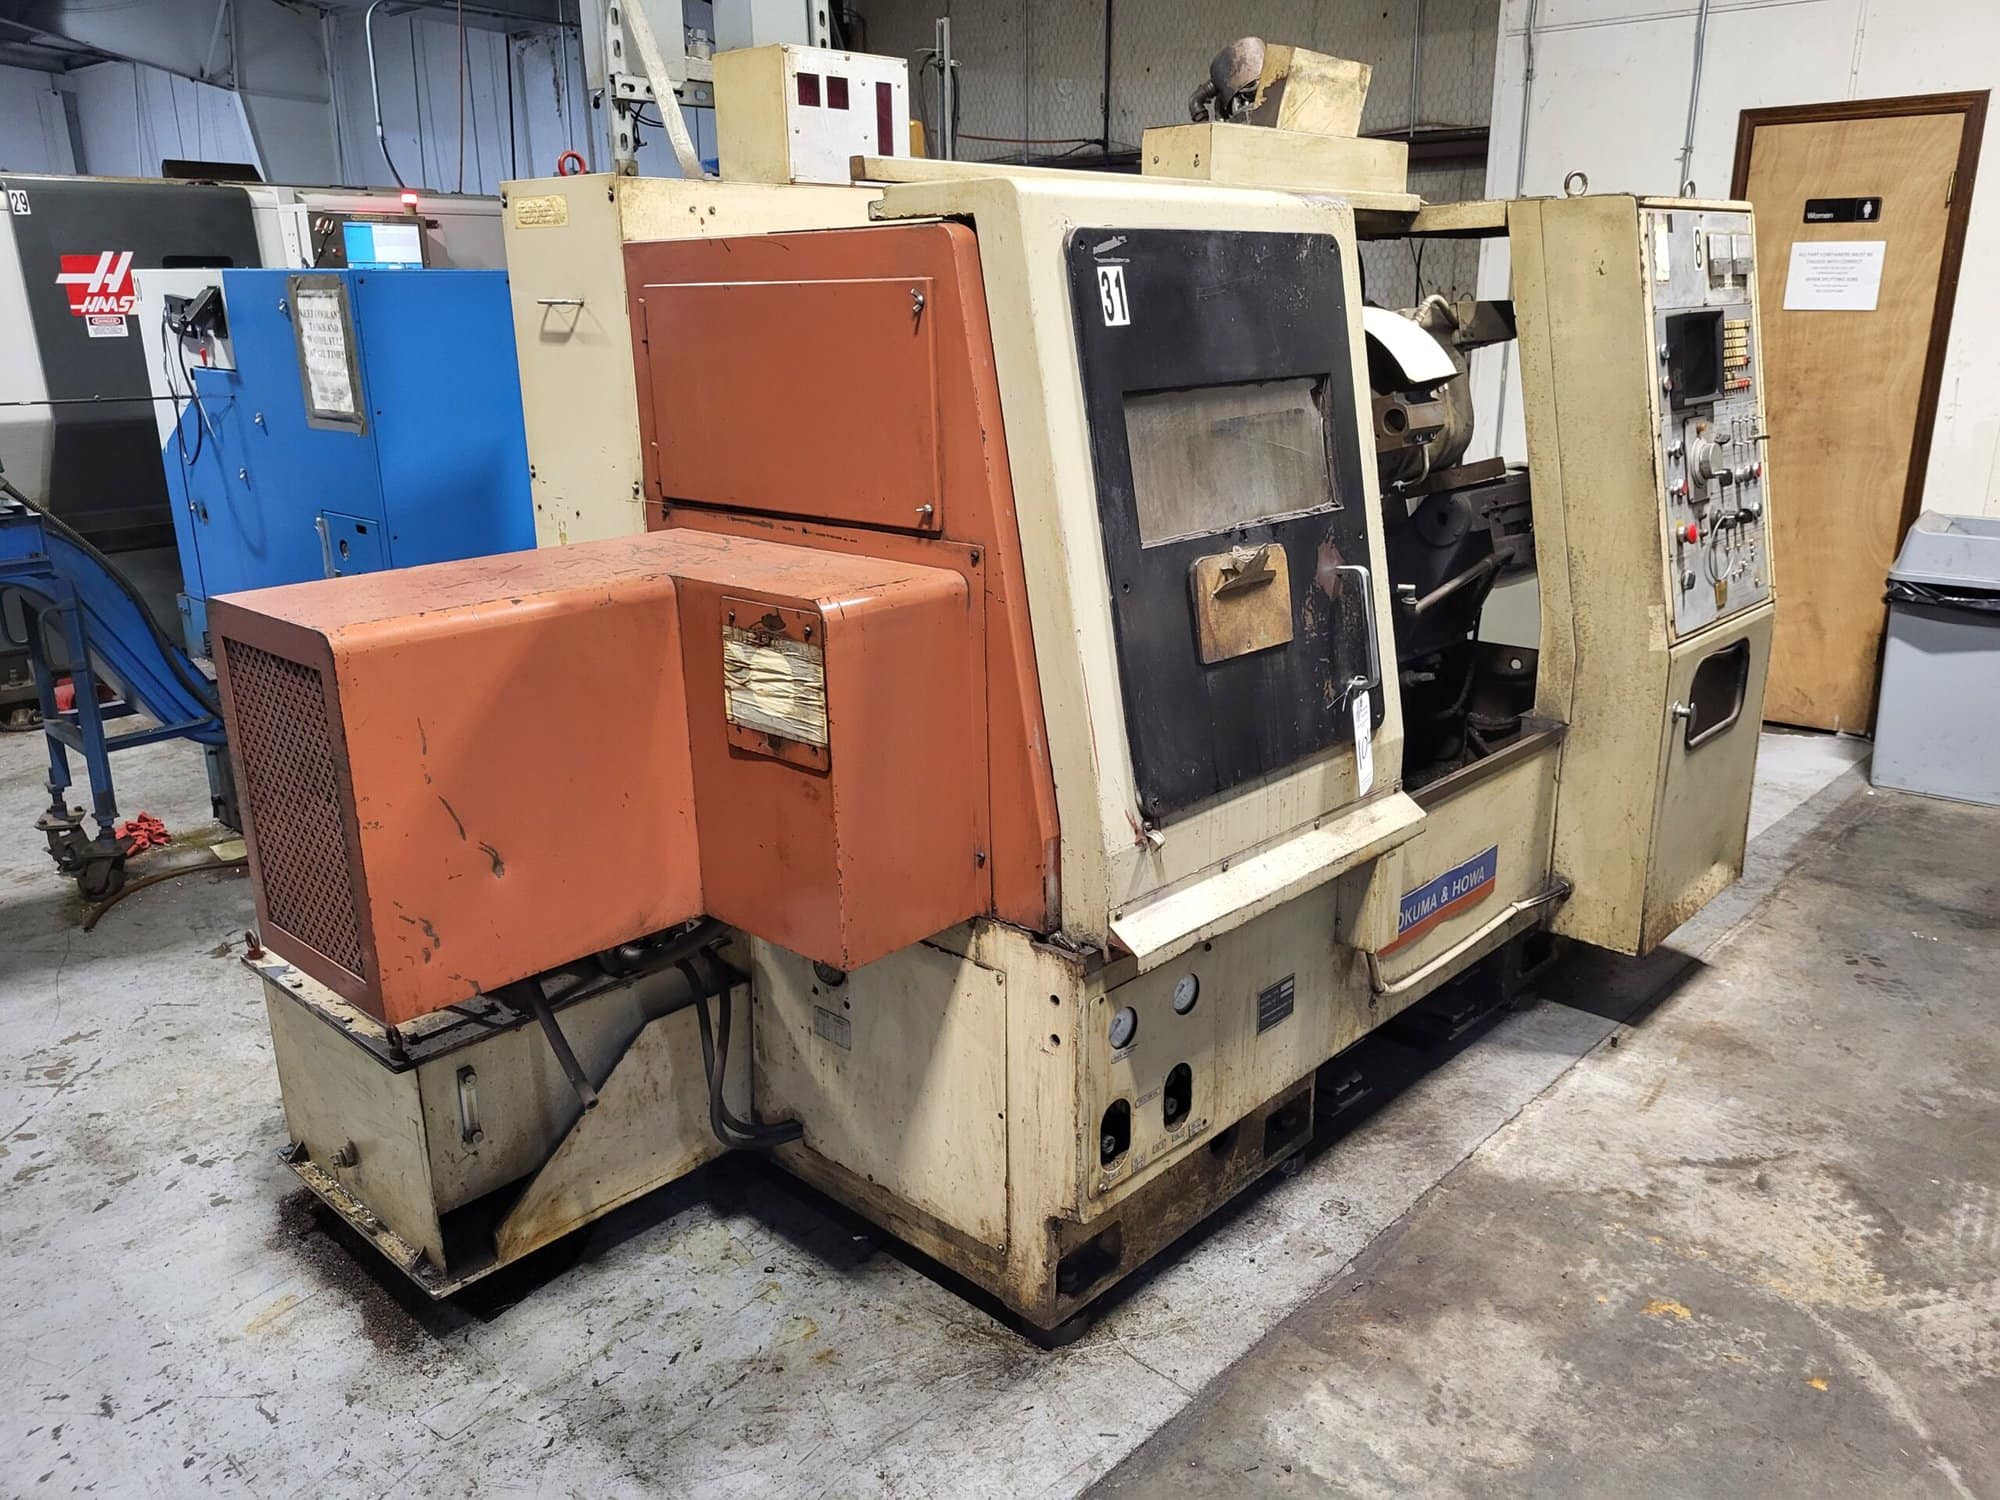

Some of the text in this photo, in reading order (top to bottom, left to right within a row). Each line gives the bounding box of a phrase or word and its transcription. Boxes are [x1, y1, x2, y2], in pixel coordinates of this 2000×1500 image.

[11, 192, 28, 212] 29
[70, 295, 135, 313] HAAS
[1101, 269, 1126, 322] 31
[1441, 885, 1449, 904] &
[1452, 865, 1485, 897] HOWA
